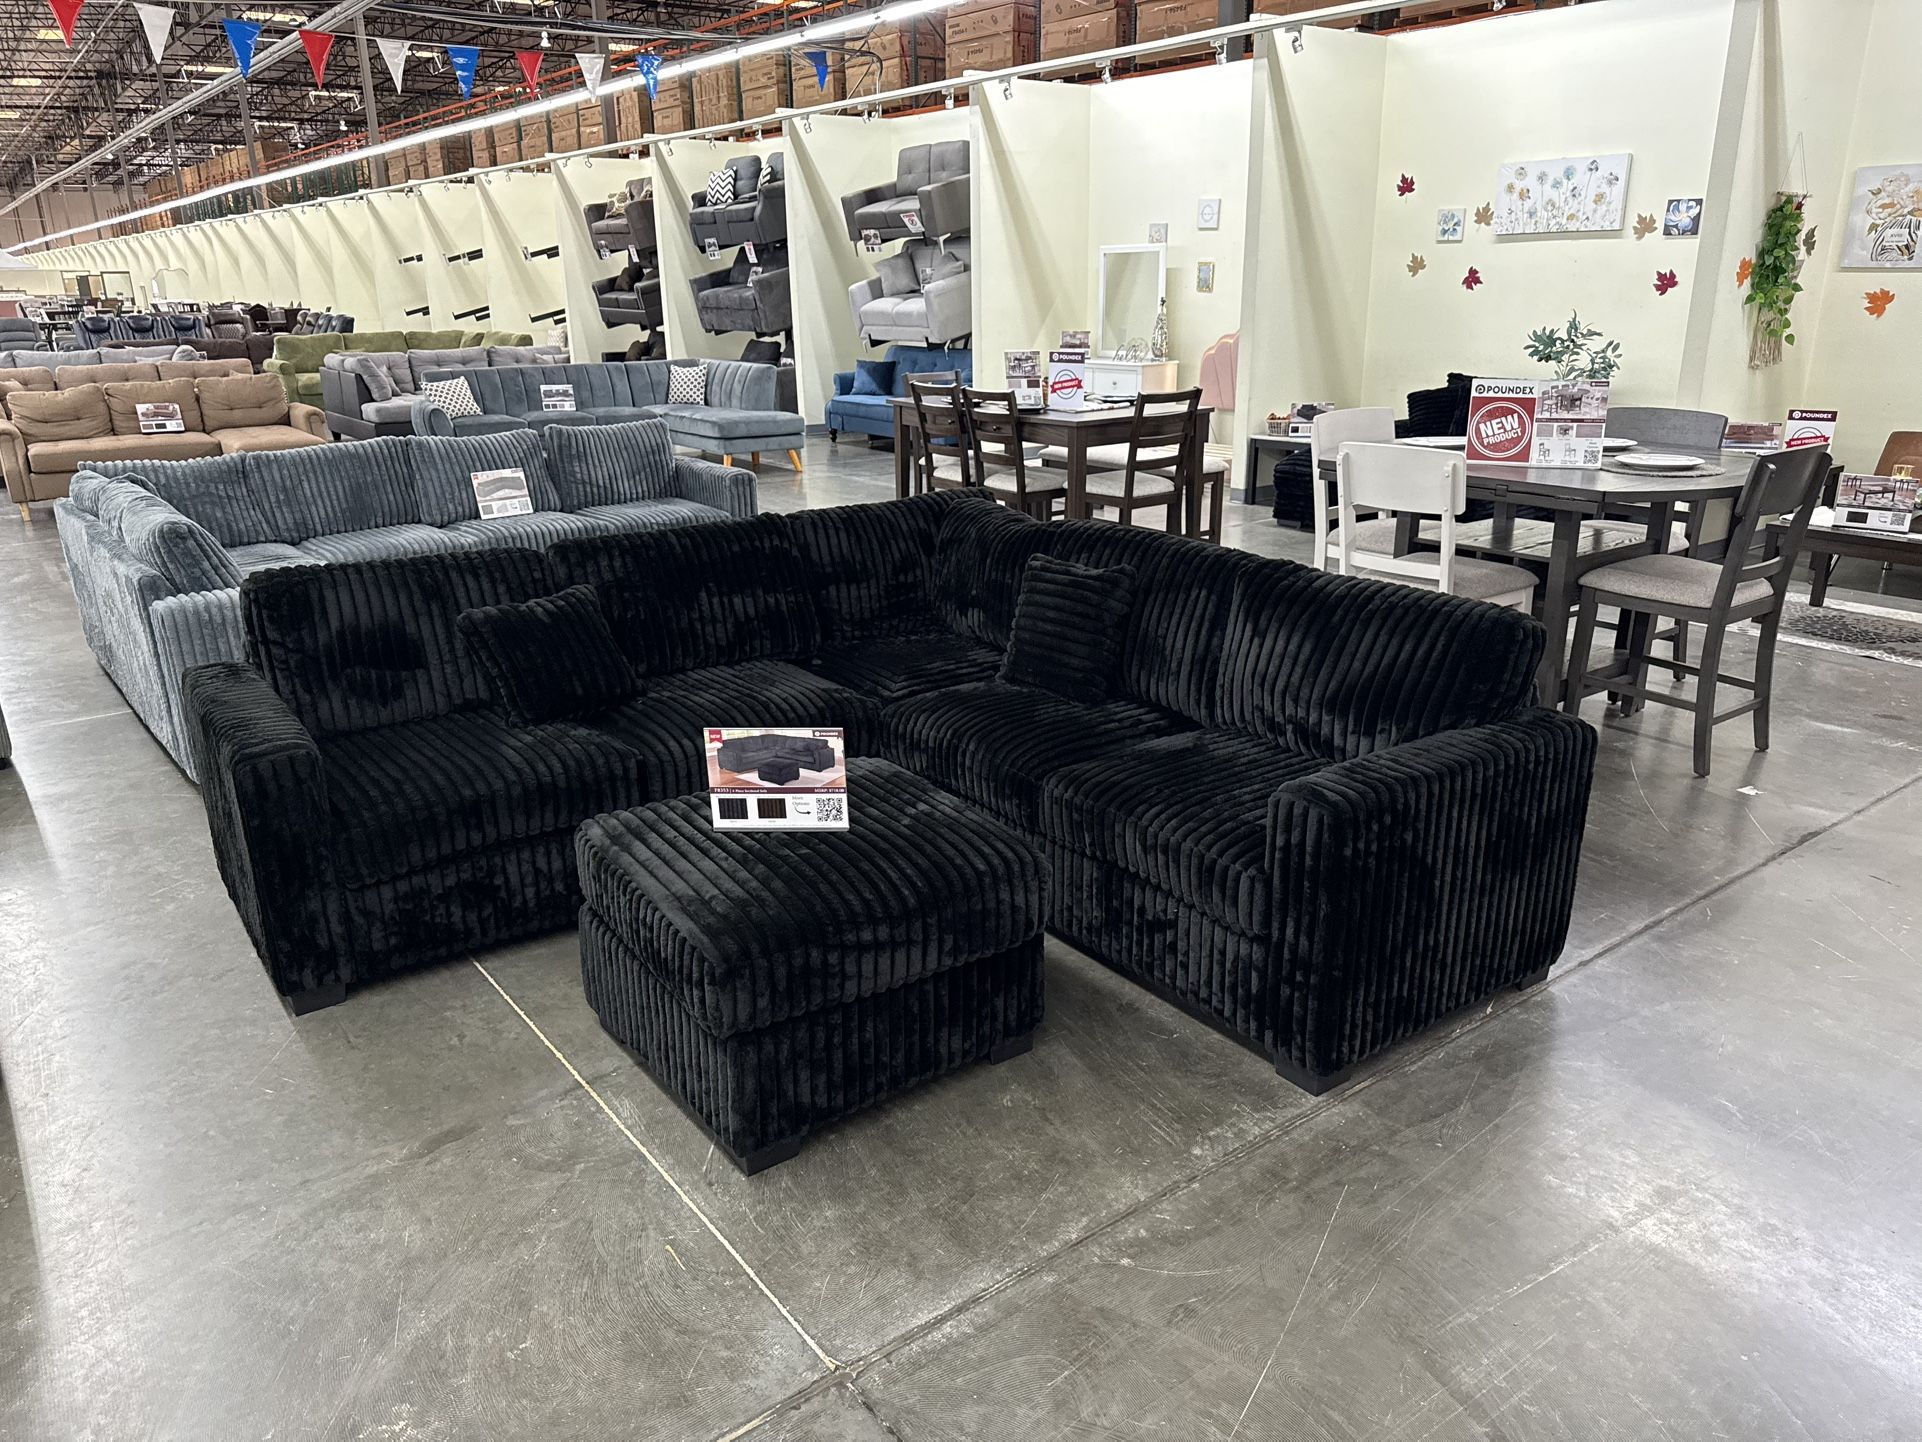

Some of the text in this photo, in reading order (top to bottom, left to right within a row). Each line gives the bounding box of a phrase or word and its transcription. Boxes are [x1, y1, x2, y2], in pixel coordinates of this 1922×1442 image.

[1486, 385, 1534, 395] POUNDEX
[1479, 412, 1519, 439] NEW
[1482, 428, 1522, 446] PRODUCT
